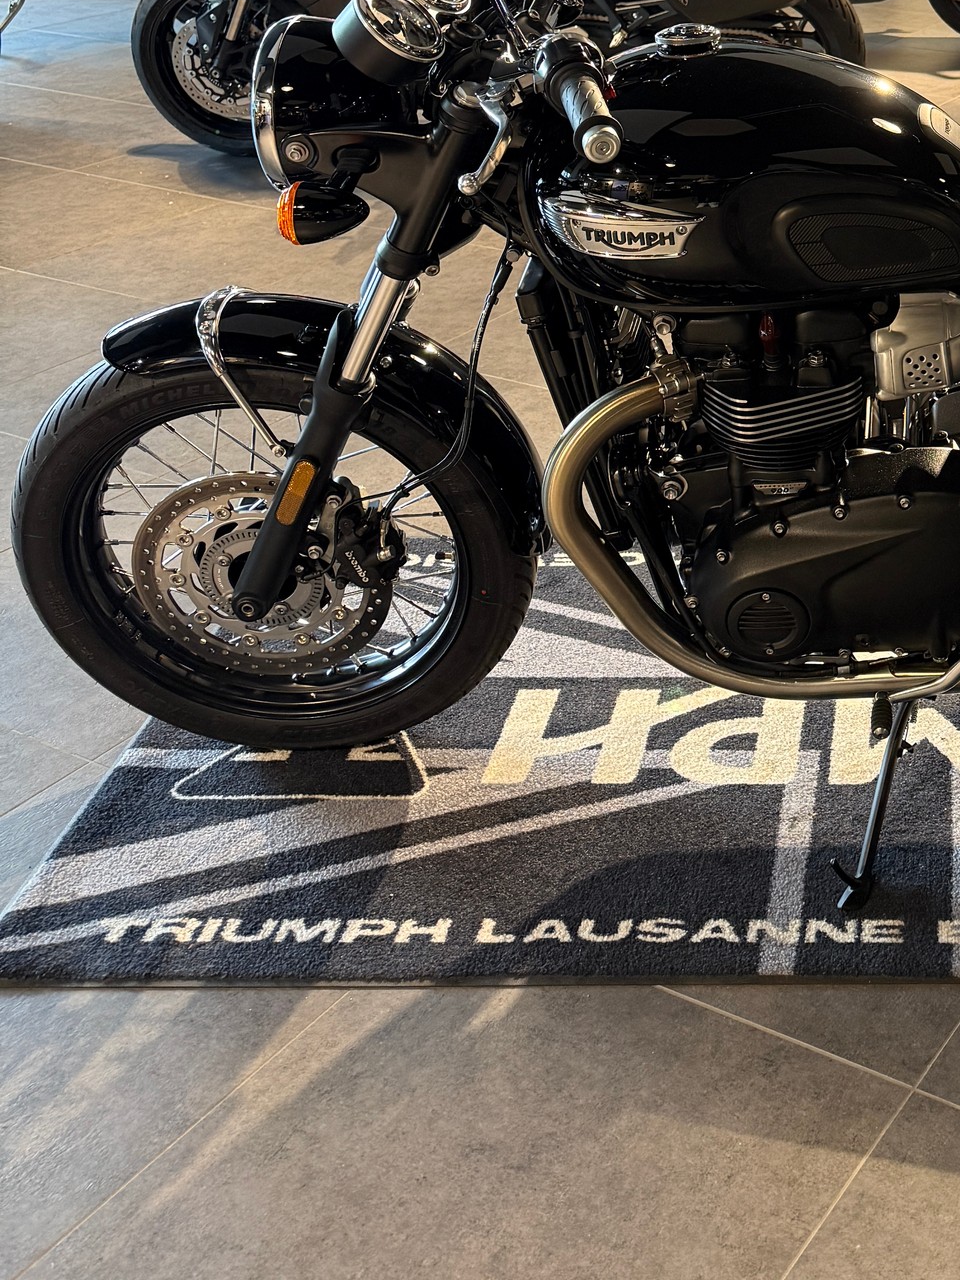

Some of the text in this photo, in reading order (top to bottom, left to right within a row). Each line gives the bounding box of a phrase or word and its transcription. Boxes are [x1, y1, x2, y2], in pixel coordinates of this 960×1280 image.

[581, 226, 676, 253] TRIUMPH
[344, 550, 369, 583] brembo
[100, 917, 454, 946] TRIUMPH
[475, 917, 906, 945] LAUSANNE
